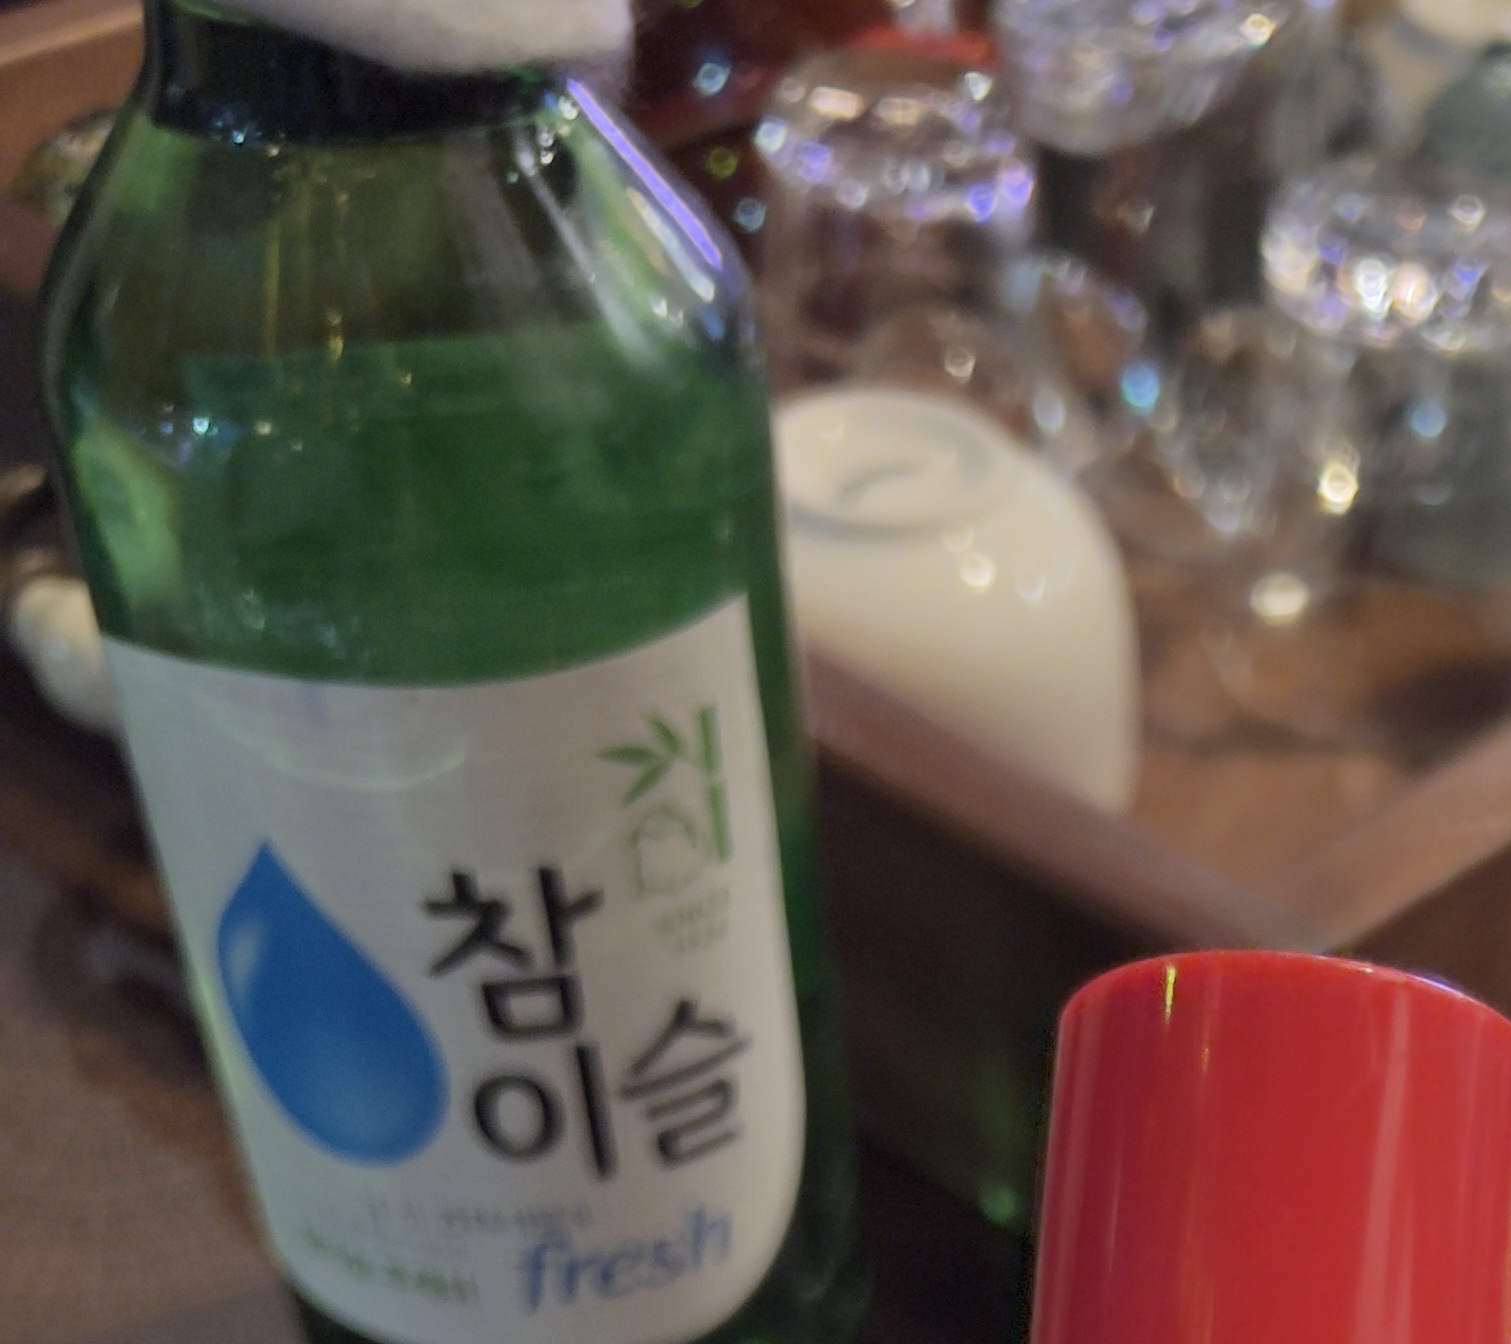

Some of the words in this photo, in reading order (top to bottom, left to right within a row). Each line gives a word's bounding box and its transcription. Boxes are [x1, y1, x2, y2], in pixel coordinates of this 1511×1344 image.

[423, 864, 605, 1042] 참
[472, 996, 752, 1183] 이슬
[518, 1205, 733, 1315] fresh
